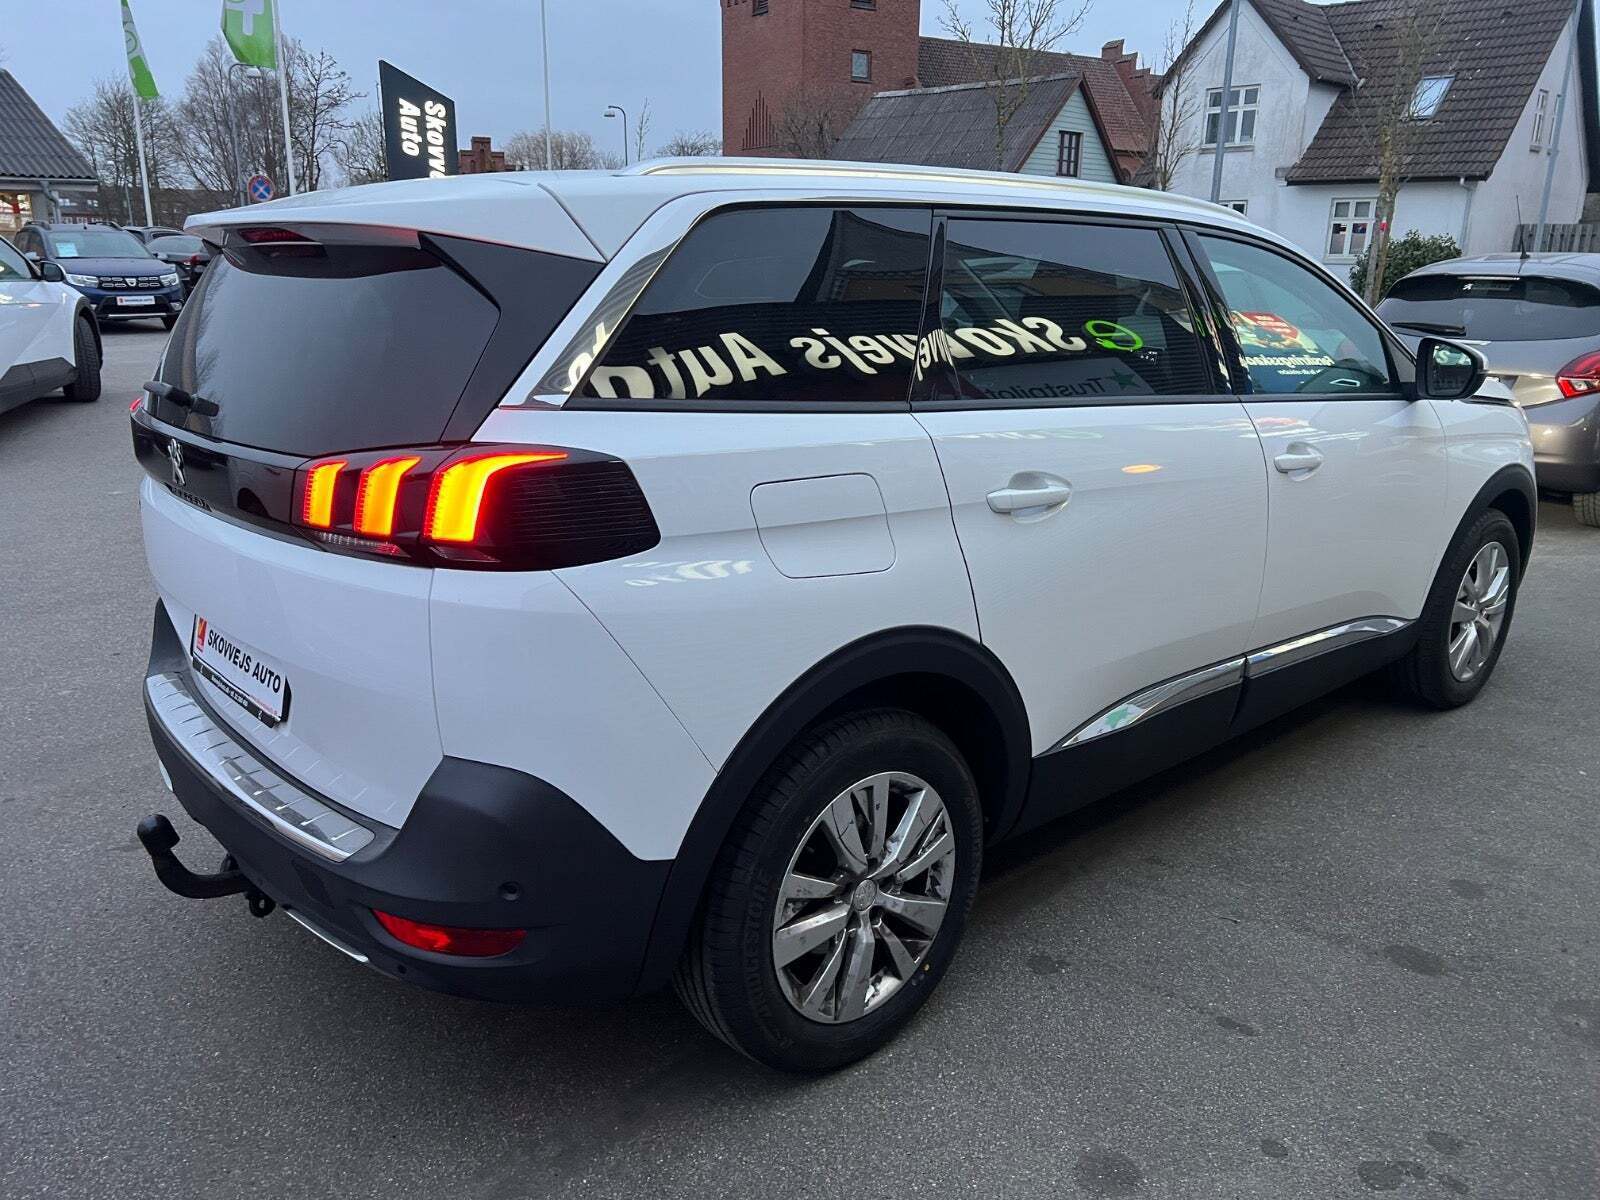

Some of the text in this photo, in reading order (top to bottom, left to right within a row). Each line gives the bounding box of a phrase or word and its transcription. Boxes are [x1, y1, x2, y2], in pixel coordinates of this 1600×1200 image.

[398, 97, 422, 156] Auto
[207, 629, 252, 674] SKOVVEJS
[252, 662, 281, 694] AUTO
